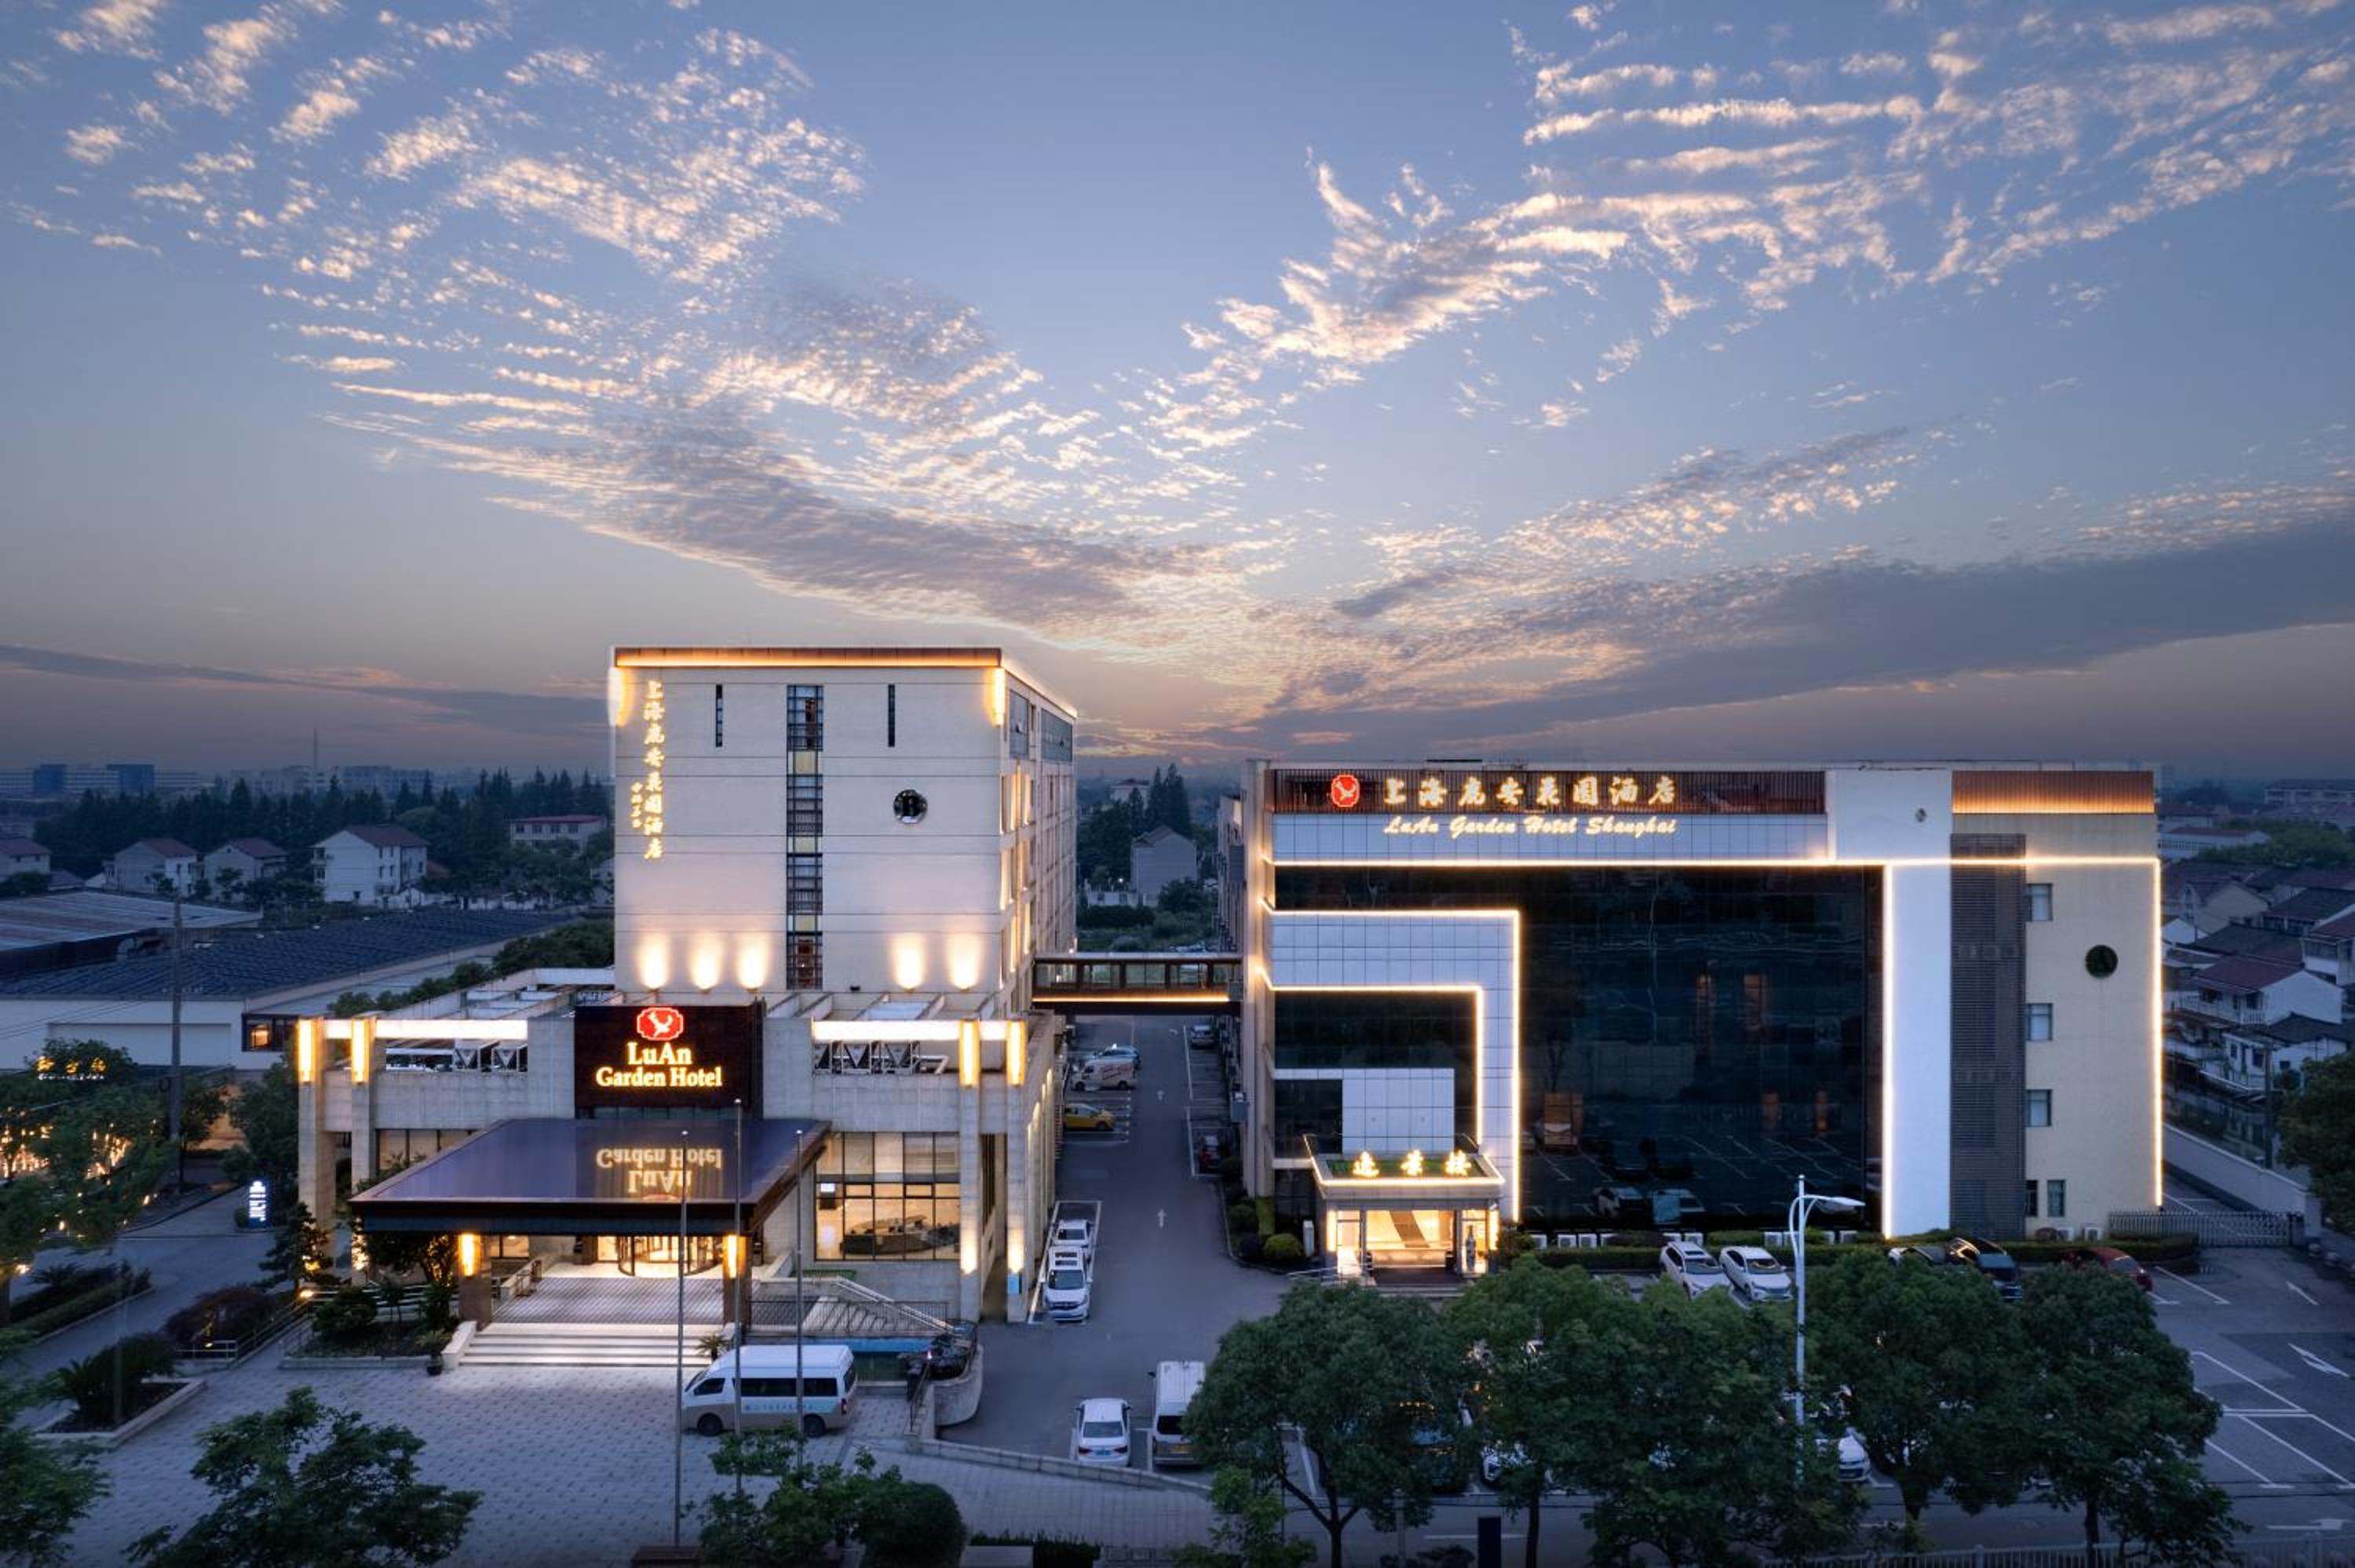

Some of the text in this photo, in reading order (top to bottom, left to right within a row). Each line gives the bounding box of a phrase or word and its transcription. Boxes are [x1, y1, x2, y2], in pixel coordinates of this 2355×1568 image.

[1449, 815, 1517, 839] Garden
[1523, 815, 1578, 834] Hotel
[1585, 815, 1677, 839] Shanghai
[626, 1041, 692, 1065] LuAn
[596, 1067, 722, 1087] Garden Hotel
